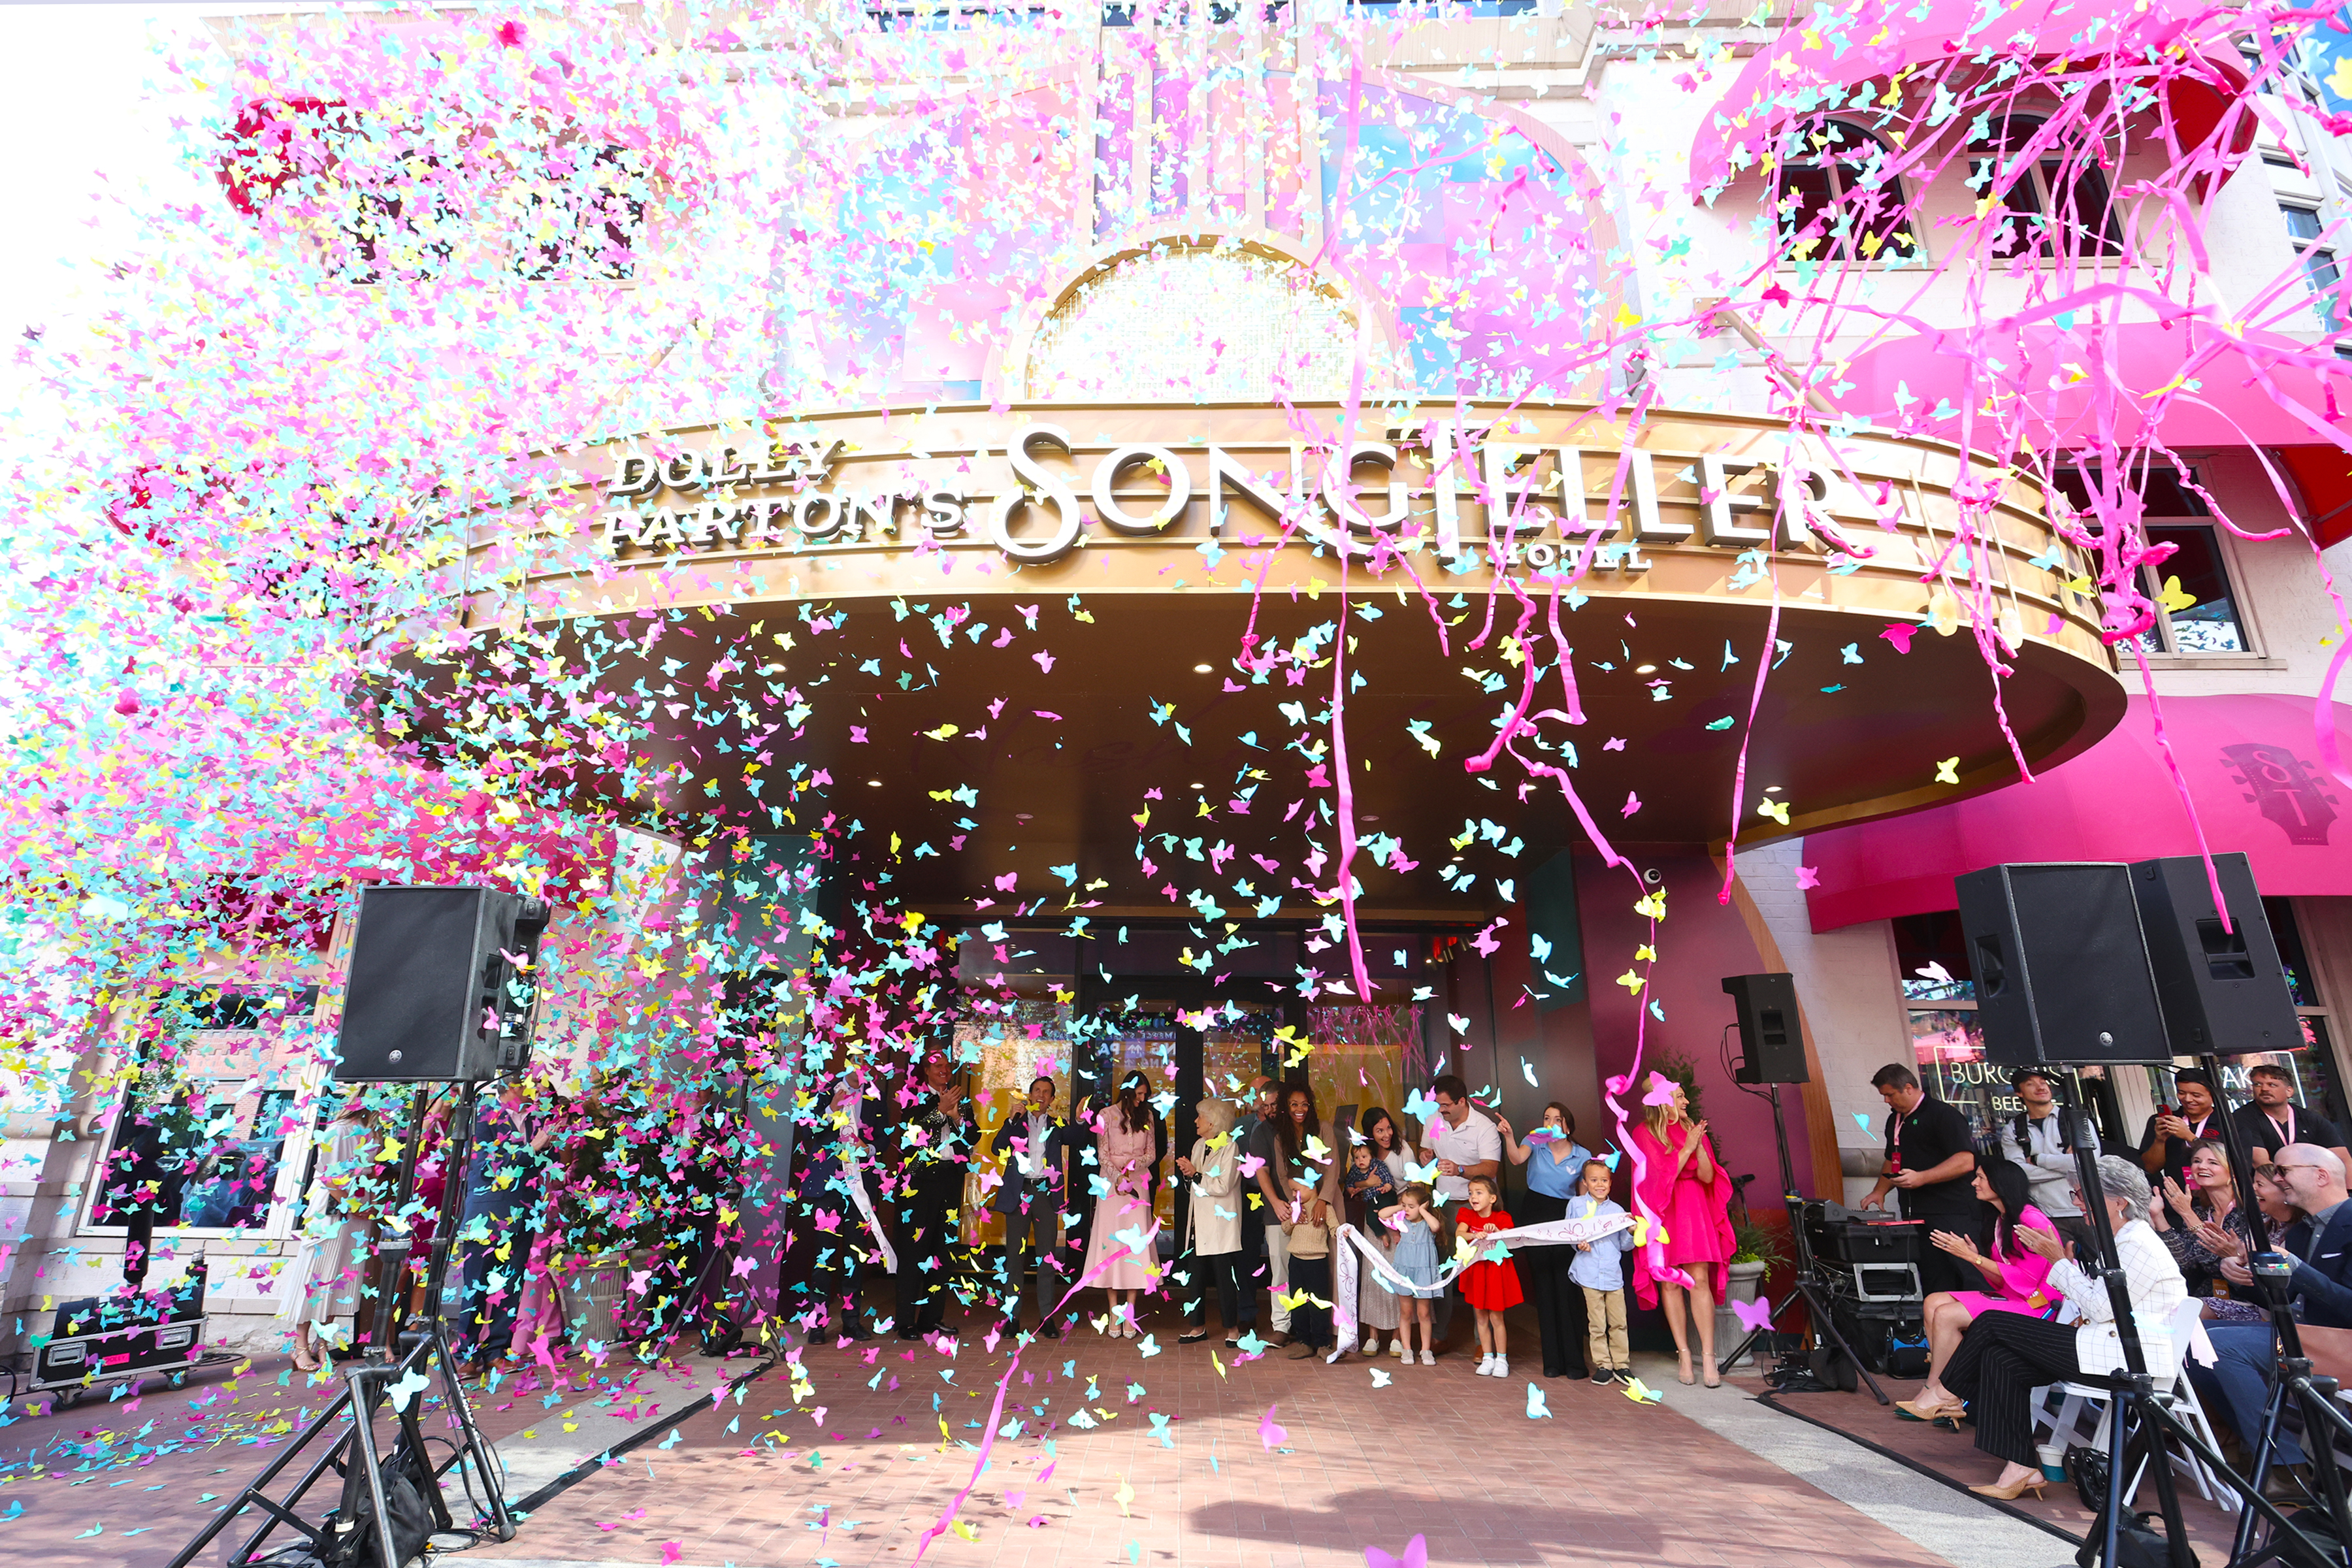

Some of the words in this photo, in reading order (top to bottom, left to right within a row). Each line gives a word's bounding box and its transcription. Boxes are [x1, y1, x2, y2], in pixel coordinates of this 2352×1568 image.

[606, 437, 845, 495] DOLLY
[988, 420, 1862, 563] SONGTELLER
[1488, 541, 1653, 570] HOTEL
[2252, 750, 2293, 783] S
[2273, 789, 2308, 826] T
[1993, 1096, 2027, 1111] BEE
[2029, 1290, 2040, 1299] IP
